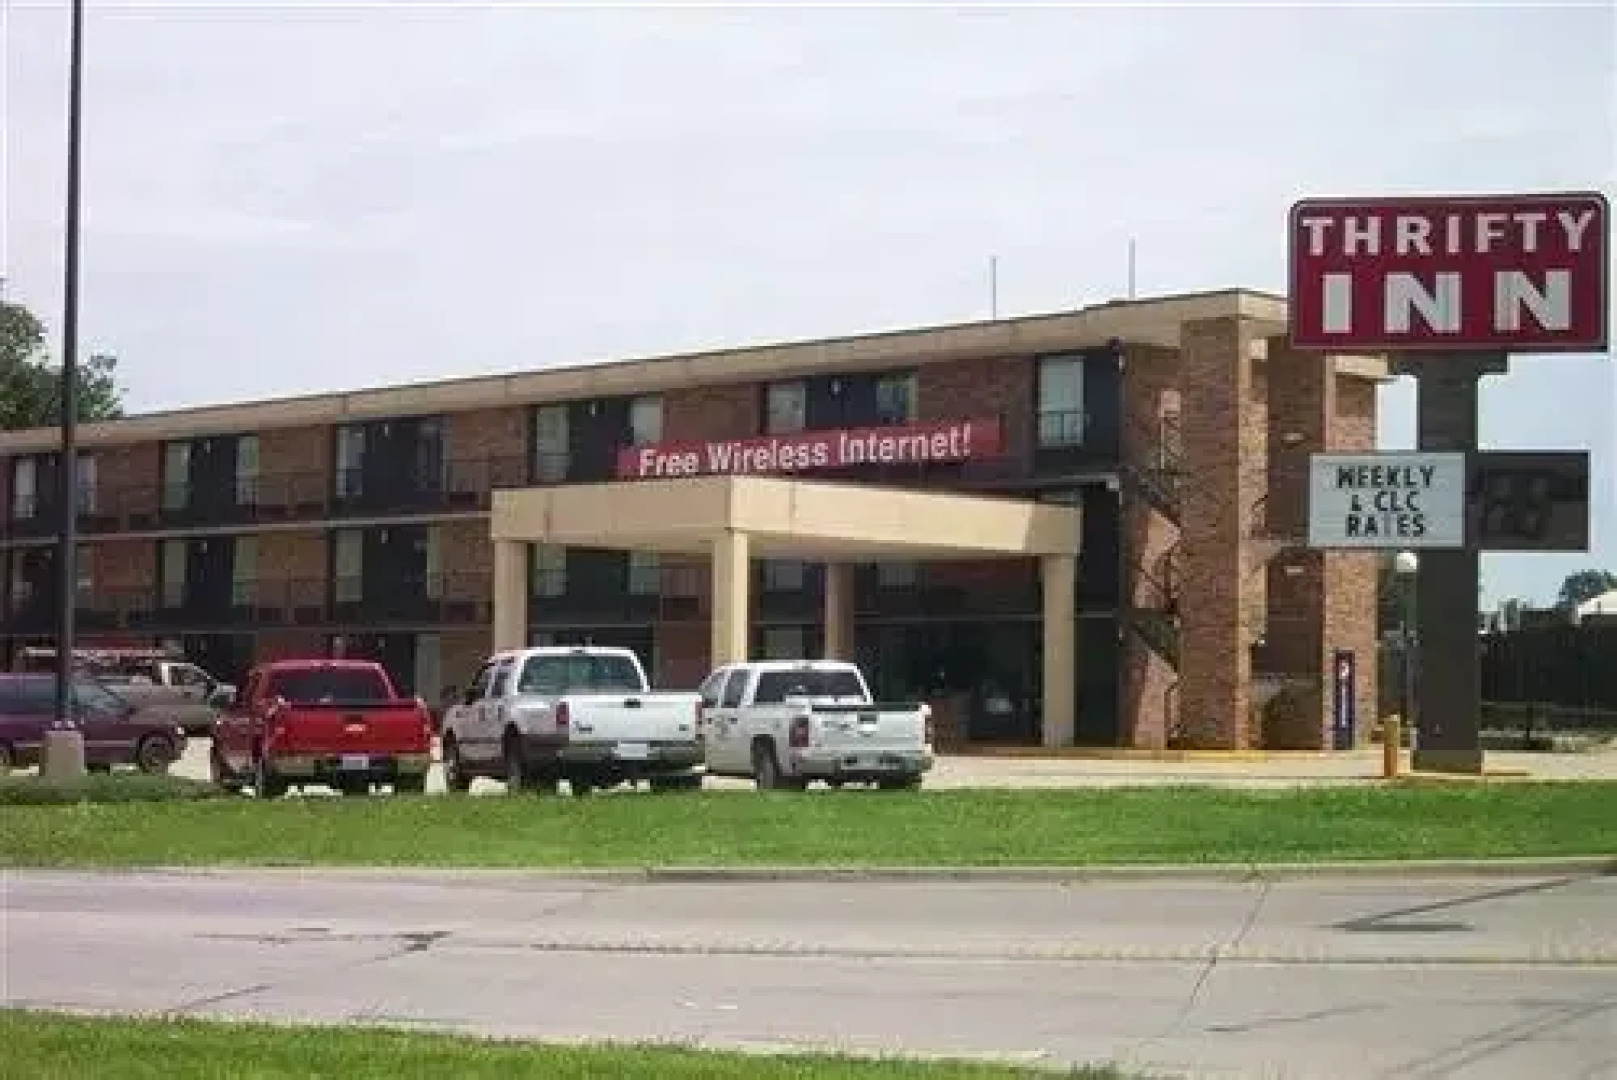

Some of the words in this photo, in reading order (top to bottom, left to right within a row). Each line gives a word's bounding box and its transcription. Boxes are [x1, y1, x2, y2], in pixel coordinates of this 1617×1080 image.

[1302, 211, 1595, 256] THRIFTY
[1322, 269, 1572, 333] INN
[639, 448, 699, 476] Free
[708, 440, 829, 474] Wireless
[839, 423, 971, 464] Internet!
[1337, 465, 1436, 488] WEEKLY
[1374, 491, 1421, 512] CLC
[1345, 514, 1426, 537] RATES
